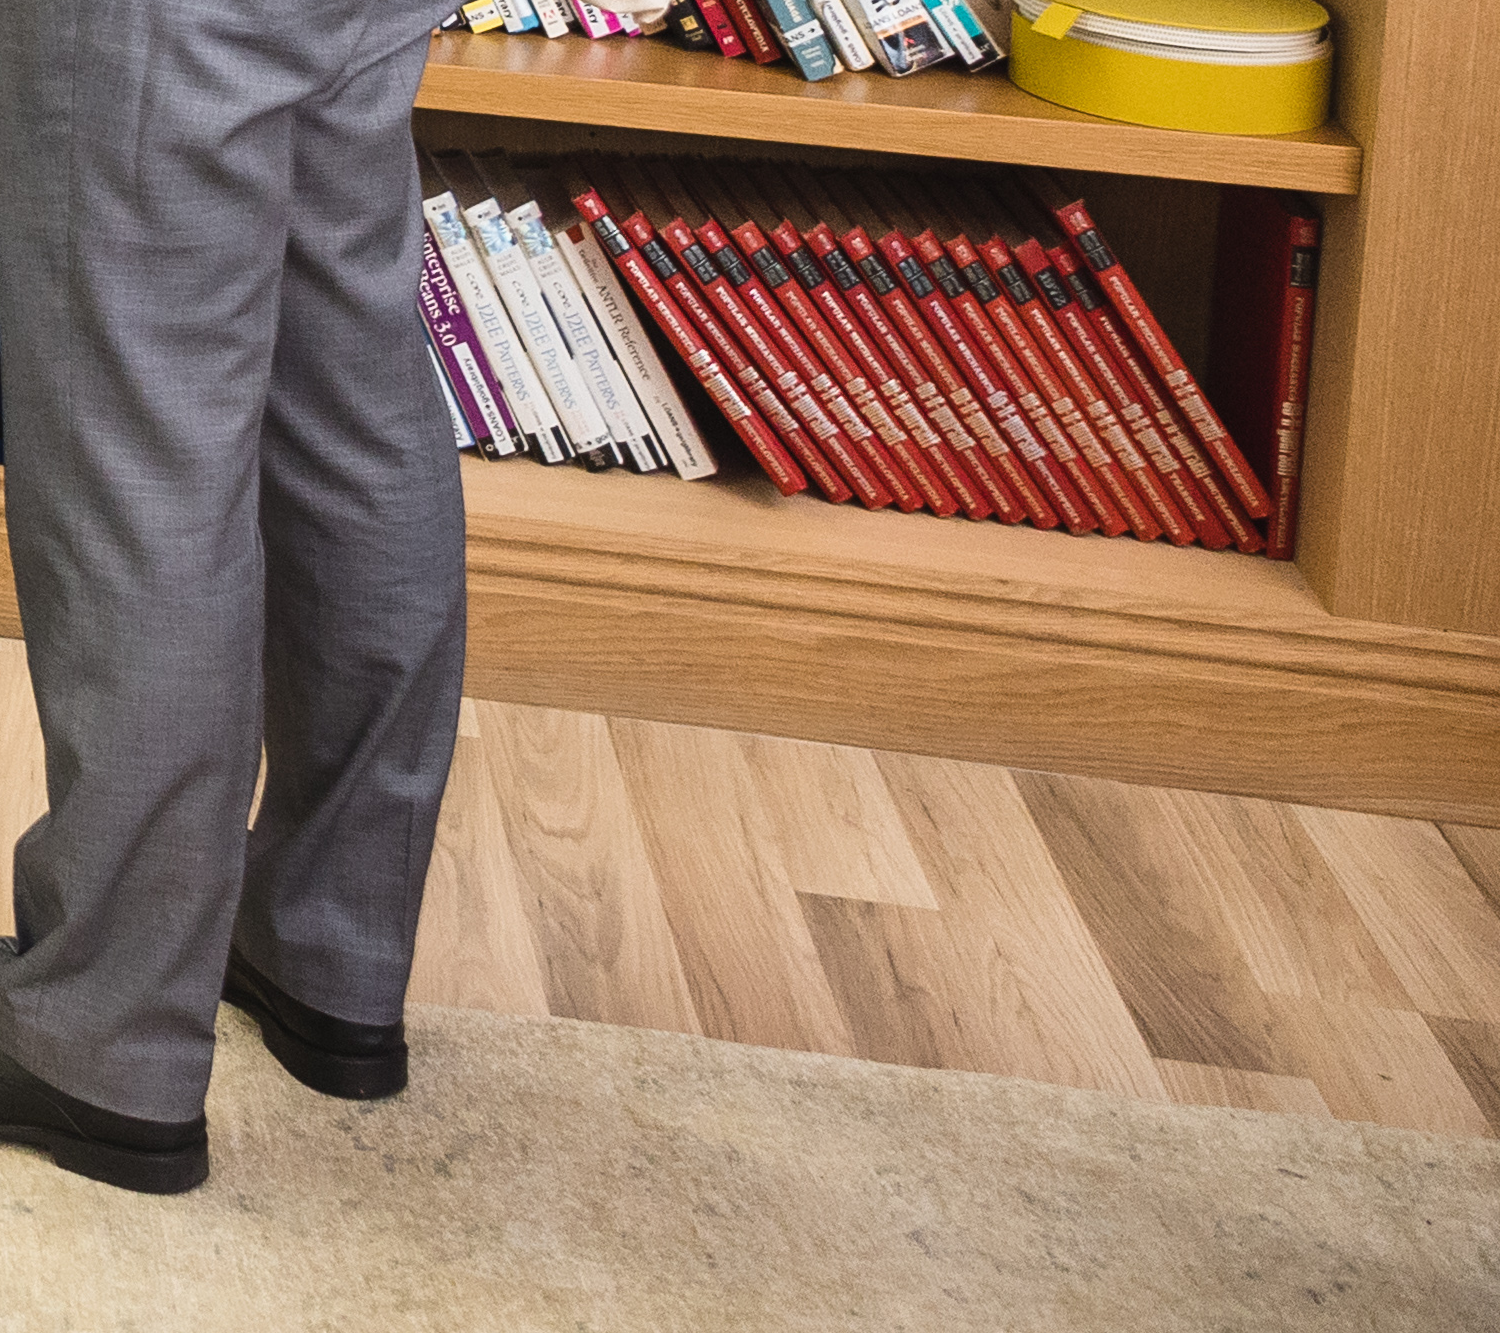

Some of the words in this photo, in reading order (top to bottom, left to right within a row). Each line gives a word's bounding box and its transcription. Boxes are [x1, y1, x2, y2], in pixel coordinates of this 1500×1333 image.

[434, 317, 457, 347] 3.0
[597, 284, 624, 329] ANTLR
[620, 326, 650, 381] Reference
[626, 259, 659, 306] POPULAR
[657, 301, 698, 353] MECHANICS
[675, 280, 708, 325] POPULAR
[715, 285, 748, 333] POPULAR
[748, 288, 783, 334] POPULAR
[475, 303, 498, 339] J2EE
[493, 339, 530, 401] PATTERNS
[522, 310, 543, 349] J2EE
[540, 347, 577, 410] PATTERNS
[562, 311, 589, 349] J2EE
[582, 346, 618, 411] PATTERNS
